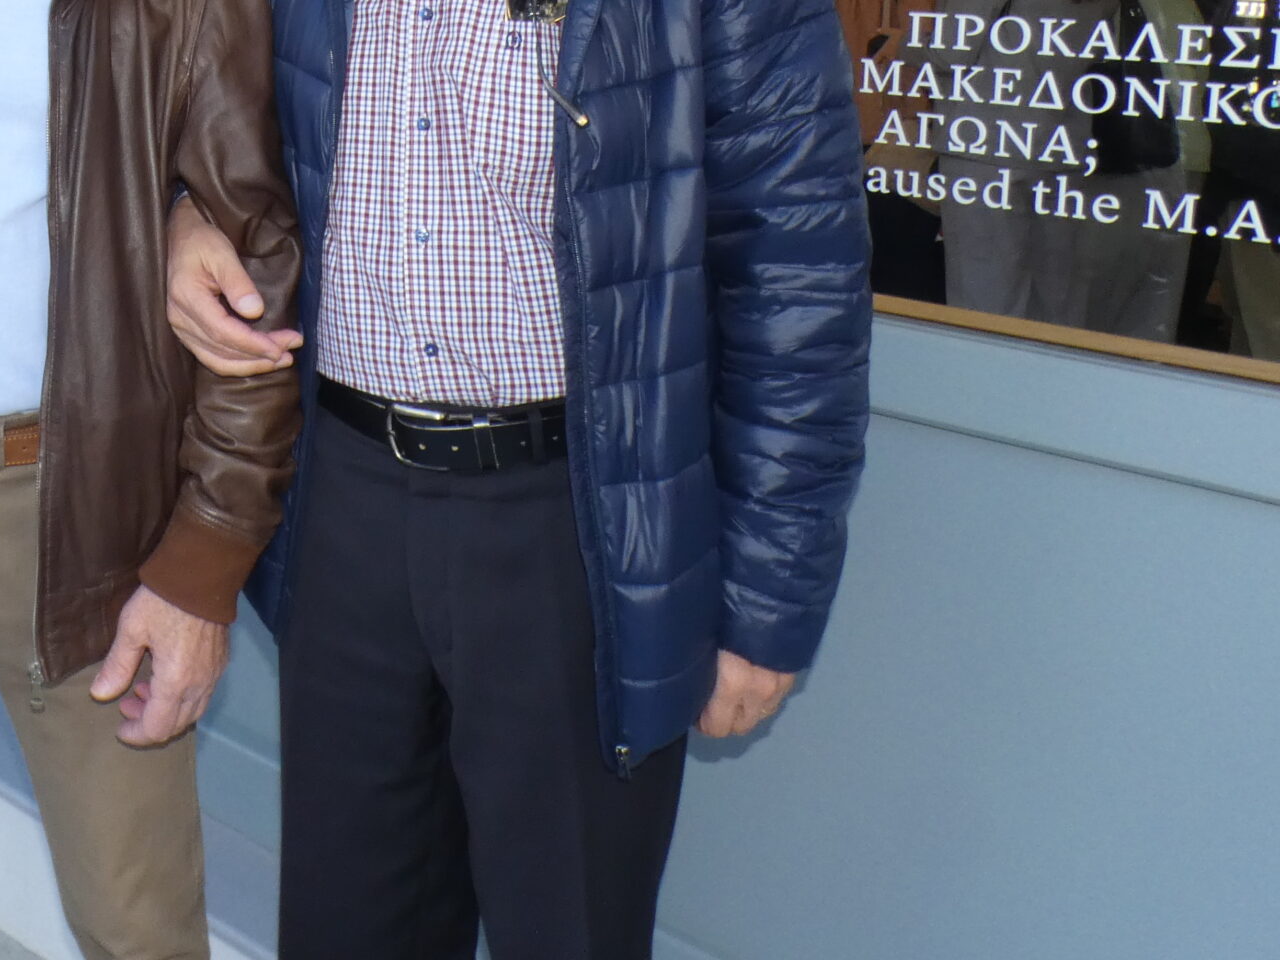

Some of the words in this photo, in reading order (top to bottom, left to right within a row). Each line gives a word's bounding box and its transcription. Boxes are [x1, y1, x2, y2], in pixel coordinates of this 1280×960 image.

[874, 108, 1099, 177] ΑΓΩΝΑ;
[866, 165, 1013, 210] aused
[1032, 175, 1120, 224] the
[1142, 188, 1280, 245] M.A
